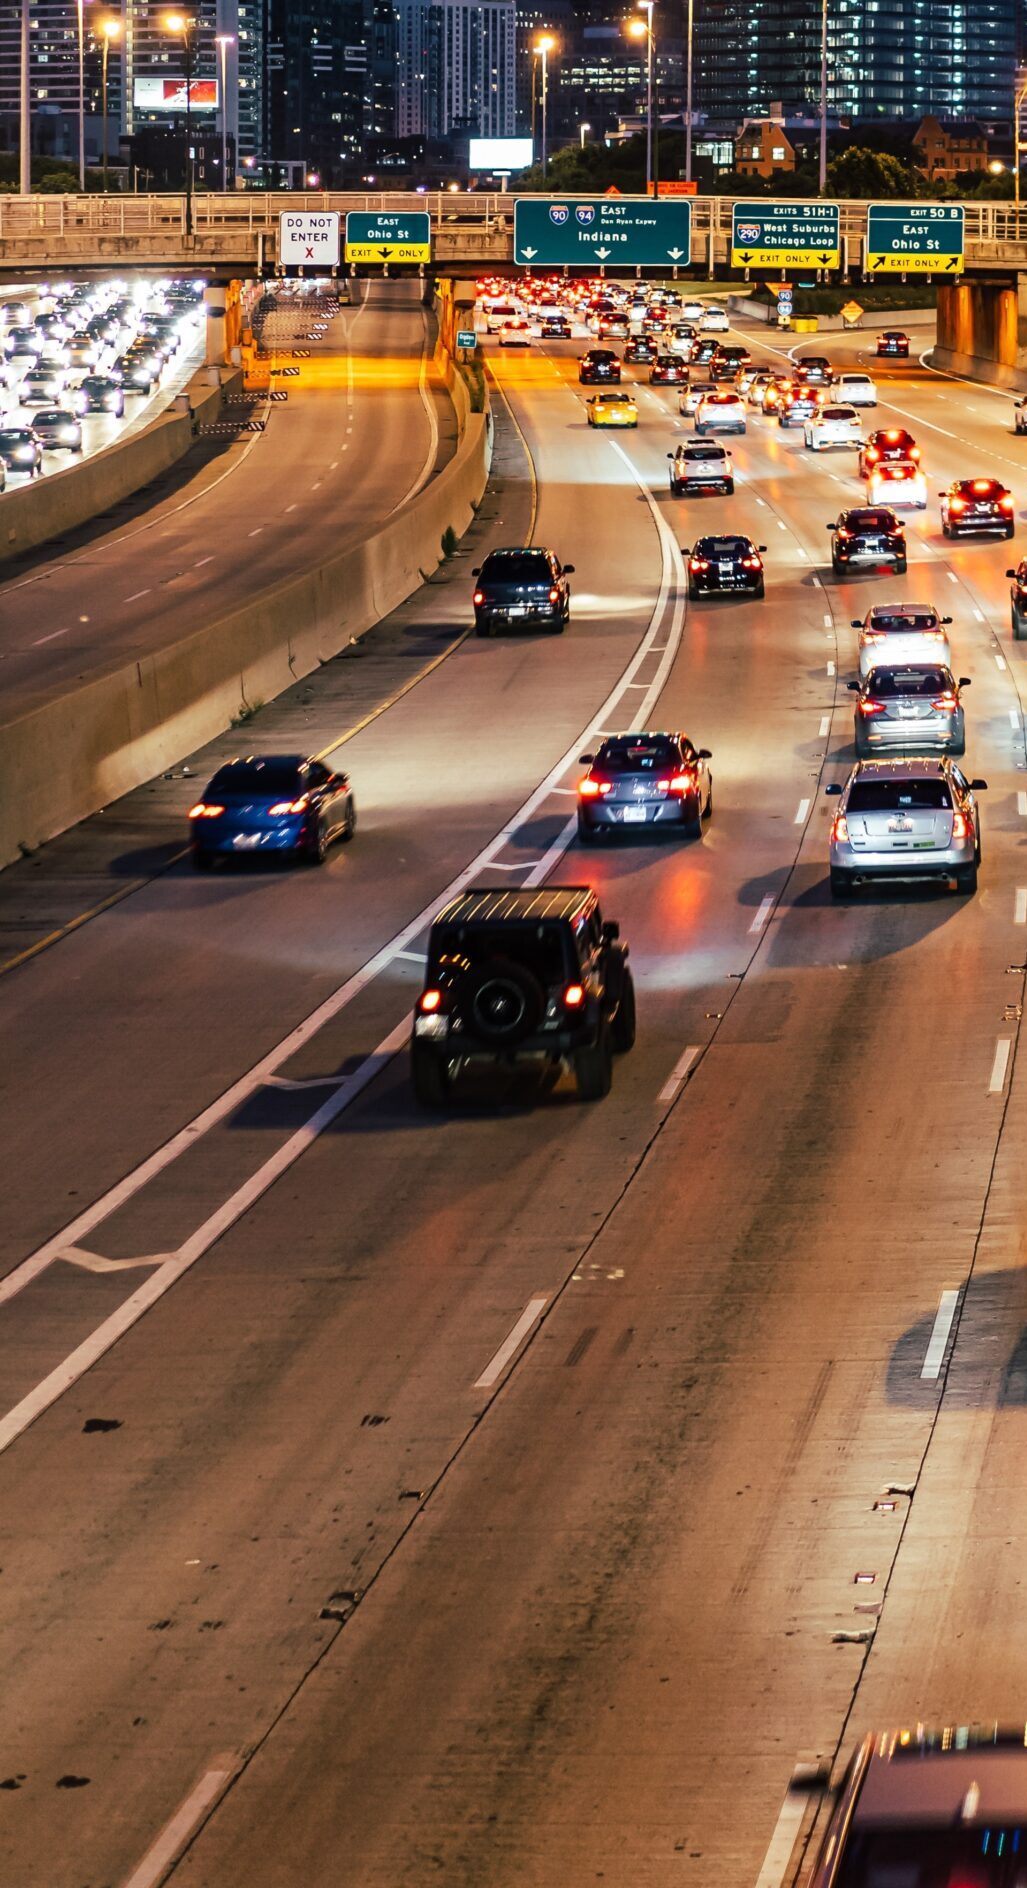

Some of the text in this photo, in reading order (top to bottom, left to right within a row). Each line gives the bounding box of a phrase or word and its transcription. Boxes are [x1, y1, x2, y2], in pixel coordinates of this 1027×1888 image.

[601, 205, 627, 215] EAST
[929, 208, 945, 218] 50
[950, 208, 959, 218] B
[552, 211, 566, 221] 90
[578, 211, 592, 221] 94
[287, 218, 333, 227] DO NOT
[377, 217, 400, 226] EAST
[616, 218, 633, 226] Ryan
[635, 218, 657, 226] Expwy
[763, 223, 835, 233] West Suburbs
[903, 224, 929, 234] EAST
[291, 232, 329, 242] ENTER
[367, 229, 409, 239] Ohio St
[578, 231, 628, 242] Indiana
[740, 229, 758, 239] 290
[764, 236, 834, 247] Chicago Loop
[892, 239, 940, 250] Ohio St
[305, 247, 314, 258] X
[351, 249, 424, 257] EXIT ONLY
[760, 254, 779, 262] EXIT
[914, 259, 940, 267] ONLY
[780, 292, 790, 300] 90
